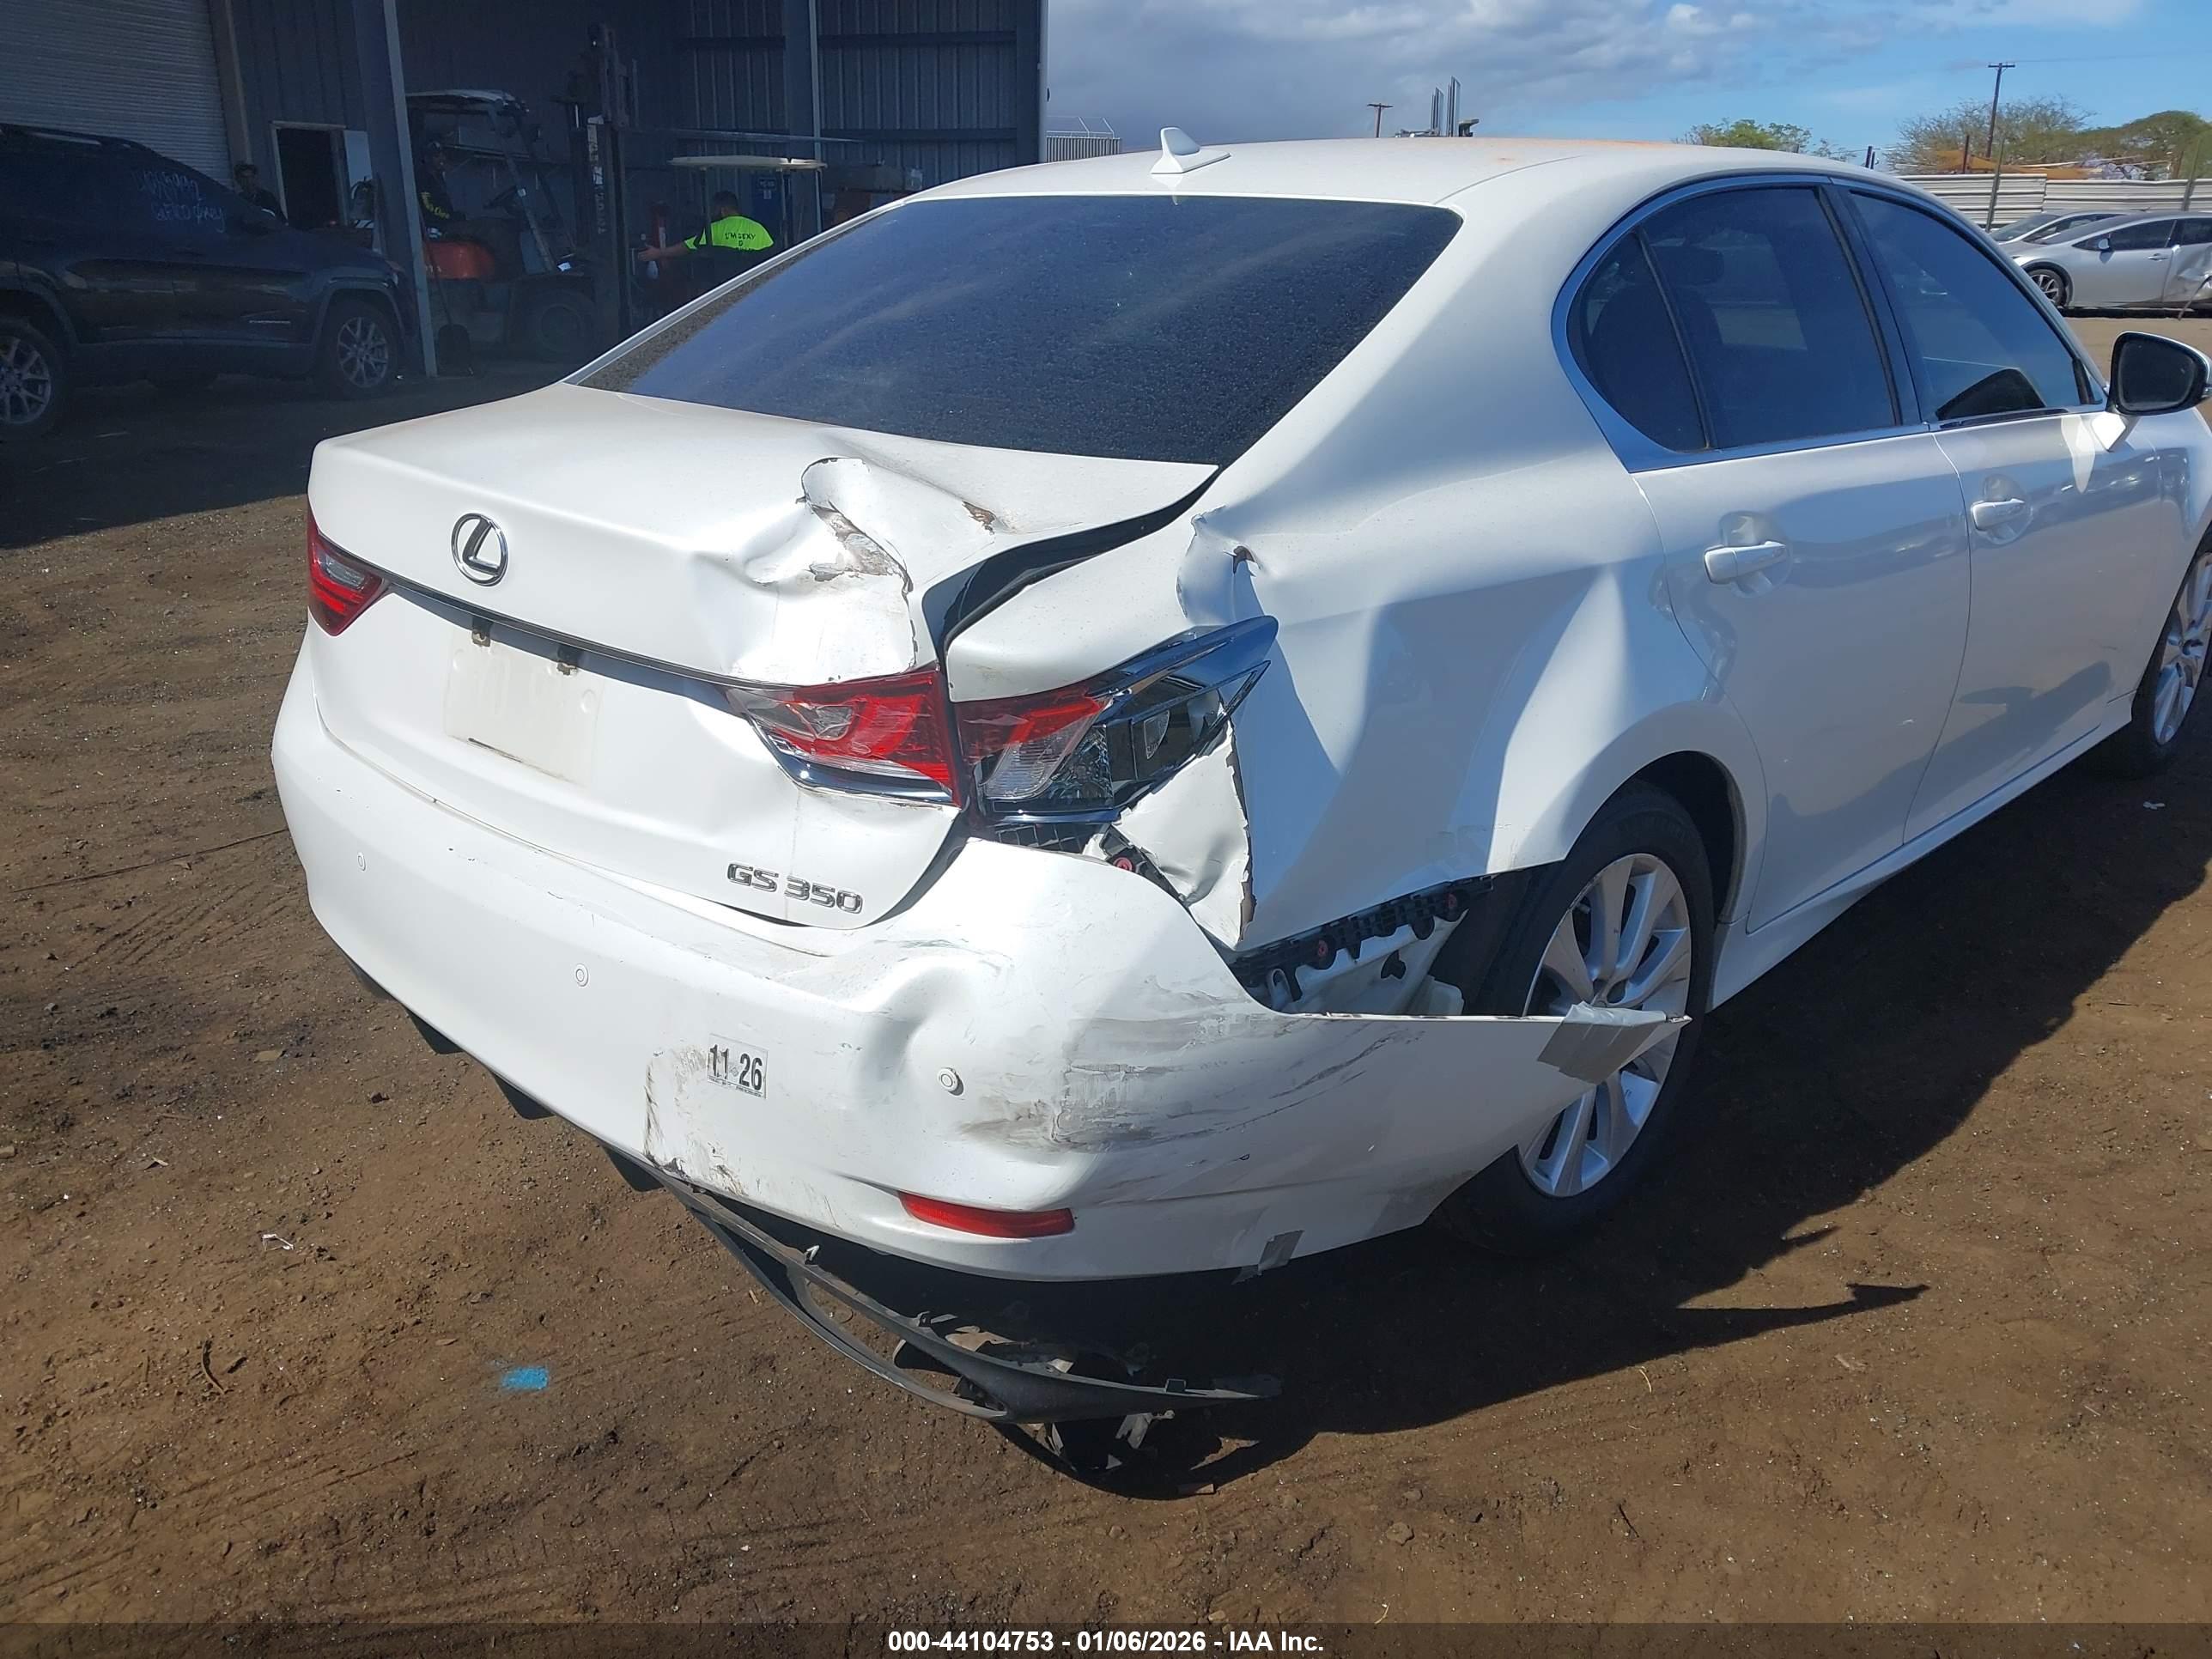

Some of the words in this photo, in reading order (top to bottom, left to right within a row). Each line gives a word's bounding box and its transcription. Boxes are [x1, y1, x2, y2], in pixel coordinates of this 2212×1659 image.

[460, 514, 501, 578] L
[727, 863, 779, 892] GS
[784, 875, 863, 914] 350
[709, 1043, 728, 1080] 11
[739, 1053, 763, 1091] 26
